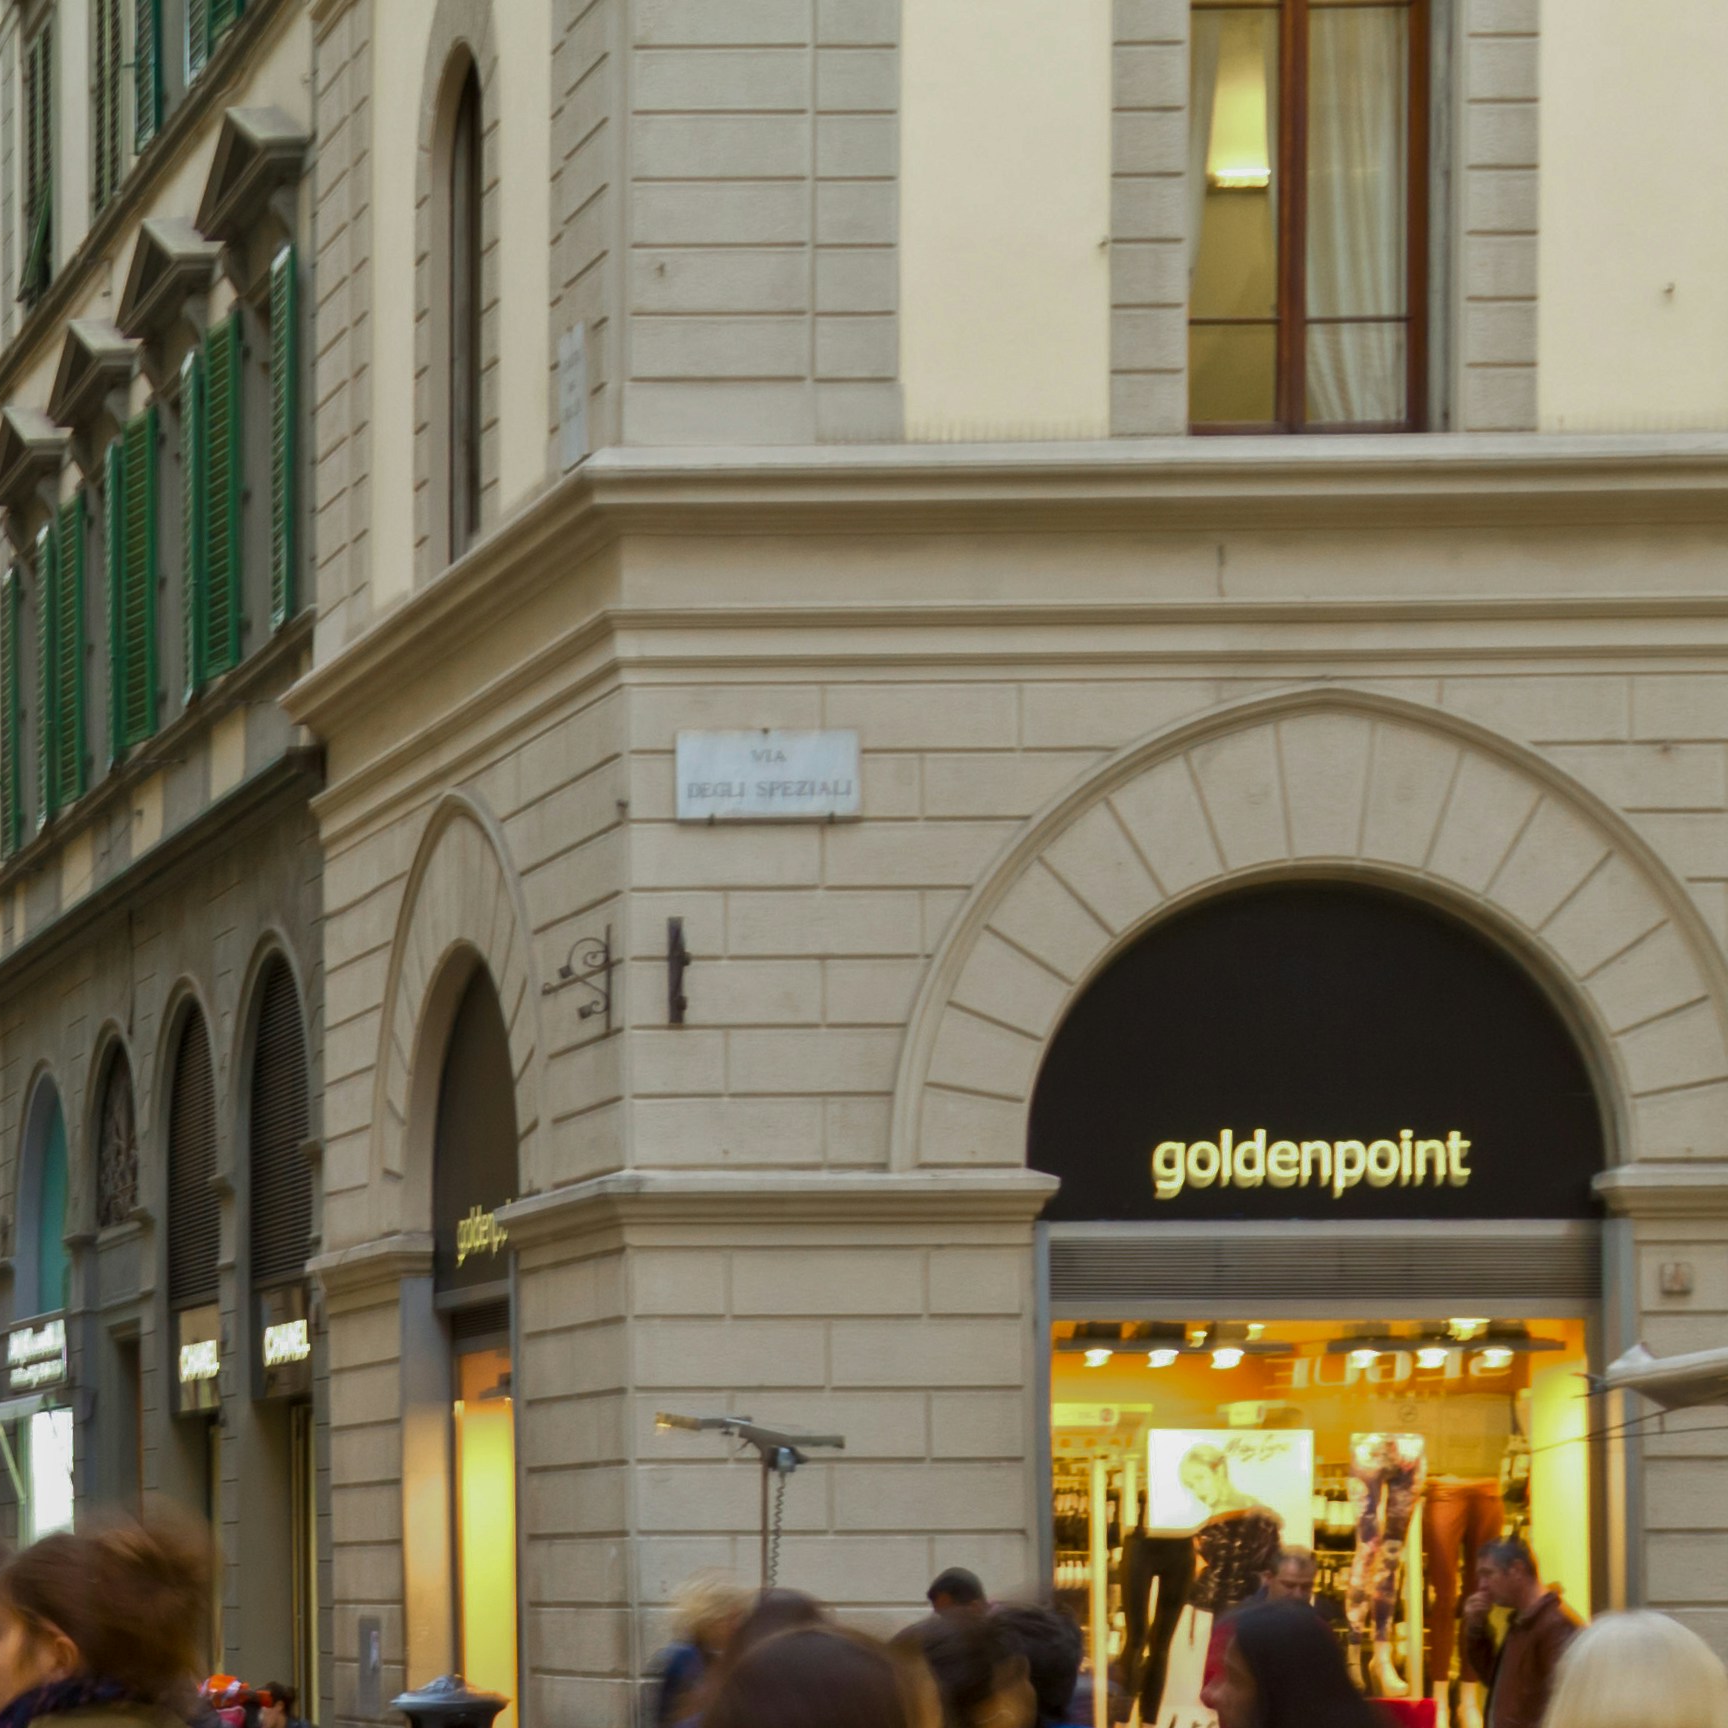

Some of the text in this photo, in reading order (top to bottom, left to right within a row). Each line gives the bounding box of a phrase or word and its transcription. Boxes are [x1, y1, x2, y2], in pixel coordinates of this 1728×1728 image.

[751, 749, 787, 763] VIA
[687, 780, 853, 799] DEGLI SPEZIALI
[1151, 1128, 1472, 1200] goldenpoint
